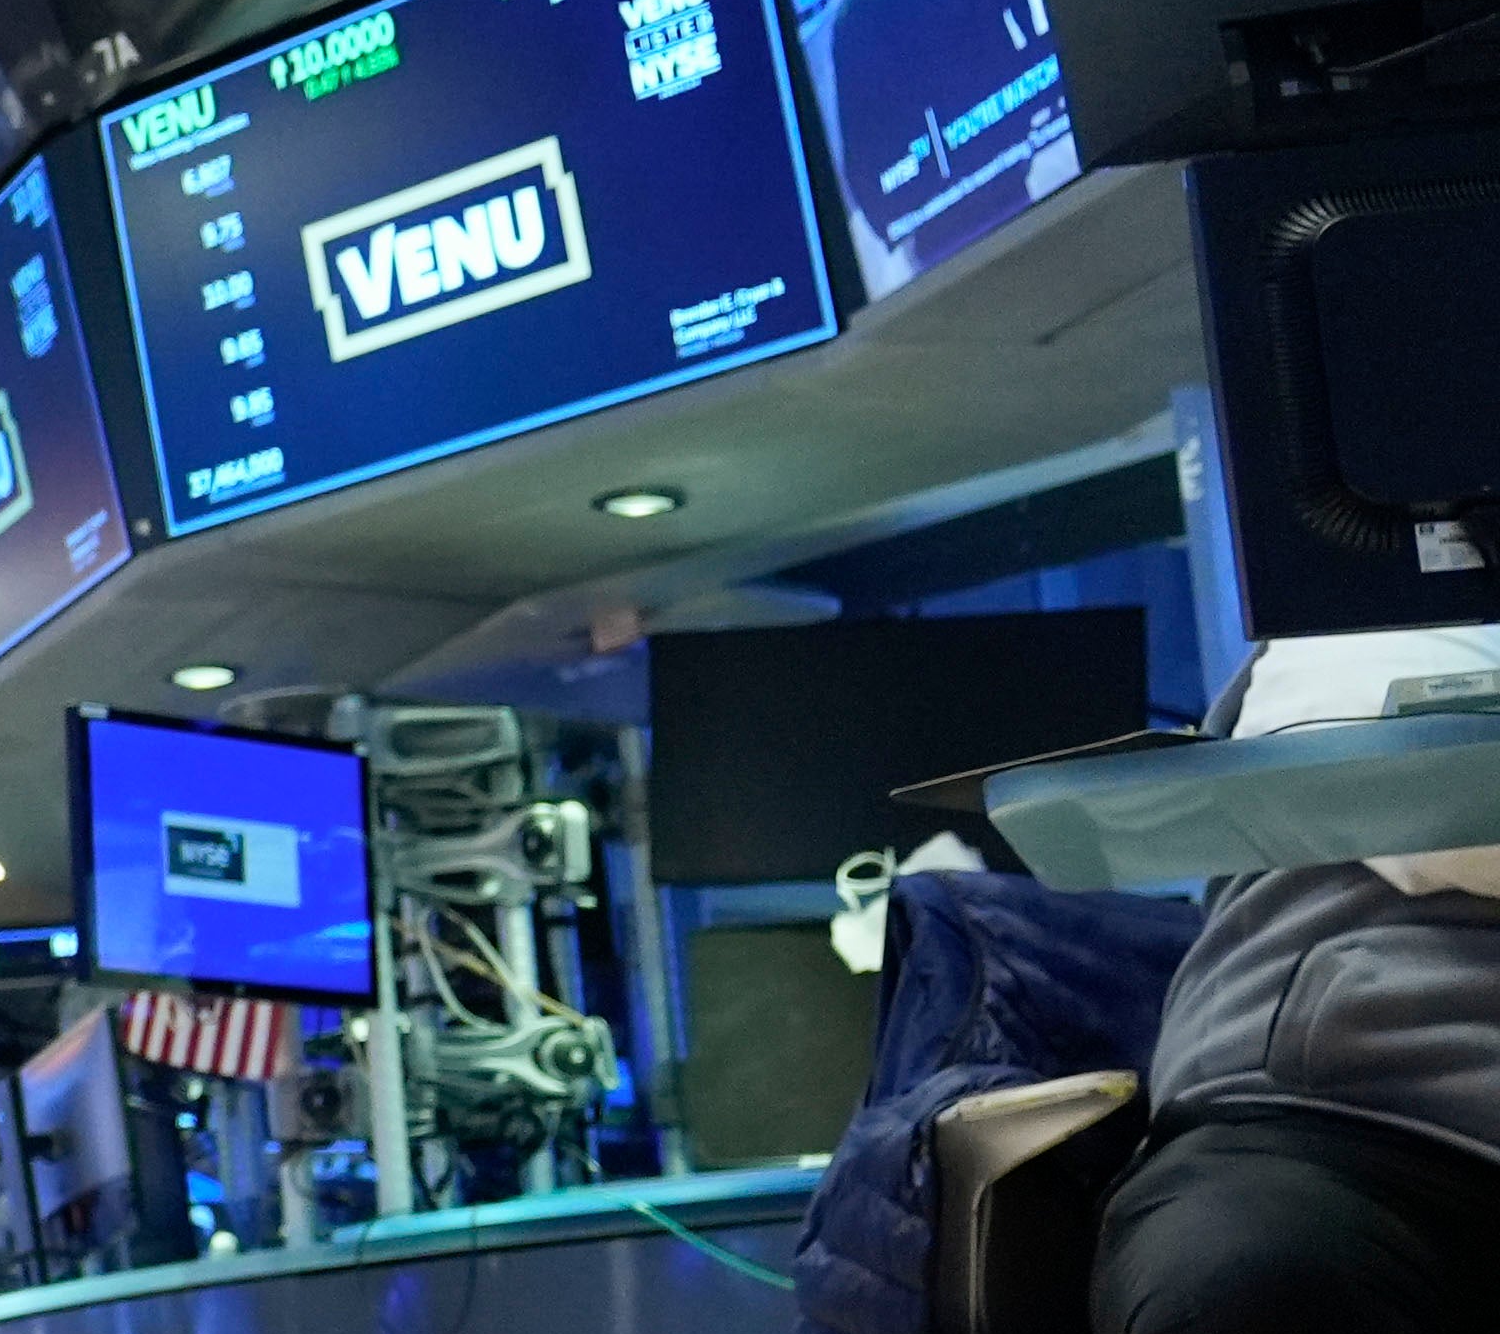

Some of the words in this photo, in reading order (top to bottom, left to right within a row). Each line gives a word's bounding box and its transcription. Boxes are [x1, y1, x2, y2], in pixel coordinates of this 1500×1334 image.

[92, 31, 140, 77] 7A
[286, 10, 396, 86] 10.0000
[121, 84, 217, 153] VENU
[336, 185, 546, 321] VENU
